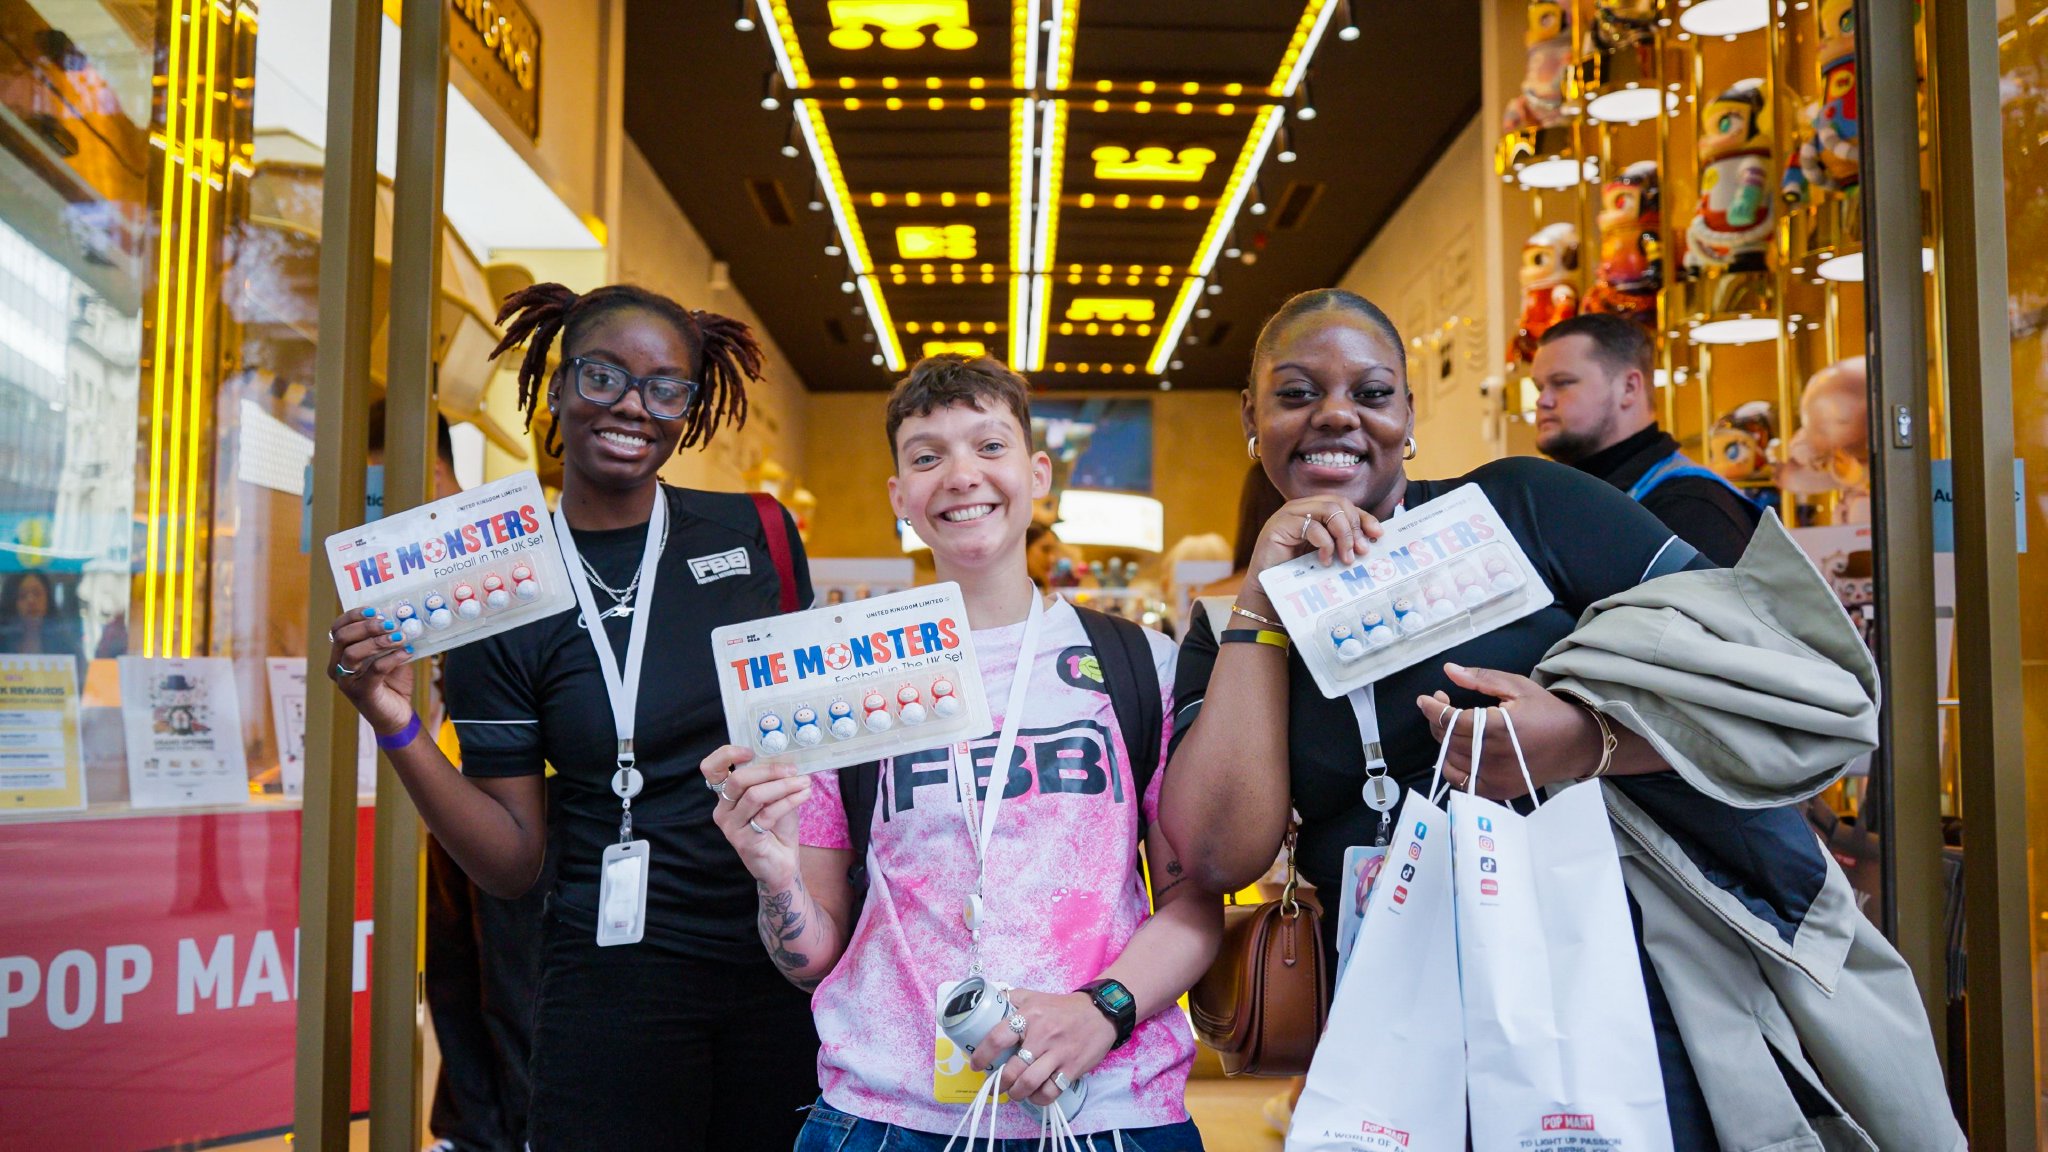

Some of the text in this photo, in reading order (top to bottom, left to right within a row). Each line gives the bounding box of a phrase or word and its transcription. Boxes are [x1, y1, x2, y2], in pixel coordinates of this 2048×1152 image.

[501, 487, 522, 498] LIMITED
[344, 504, 540, 592] THE MONSTERS
[434, 534, 545, 579] Football in The UK Set
[692, 551, 747, 578] FBB
[1283, 513, 1495, 619] THE MONSTERS
[866, 597, 944, 619] UNITED KINGDOM LIMITED
[731, 618, 960, 691] THE MONSTERS
[944, 650, 963, 663] Set
[894, 736, 1107, 813] FBB
[967, 797, 977, 832] Something
[0, 919, 374, 1038] POP MAT
[1543, 1115, 1592, 1129] POP MART
[1334, 1131, 1374, 1143] WORLD
[1377, 1137, 1391, 1147] OF
[1520, 1137, 1622, 1148] TO LIGHT UP PASSION
